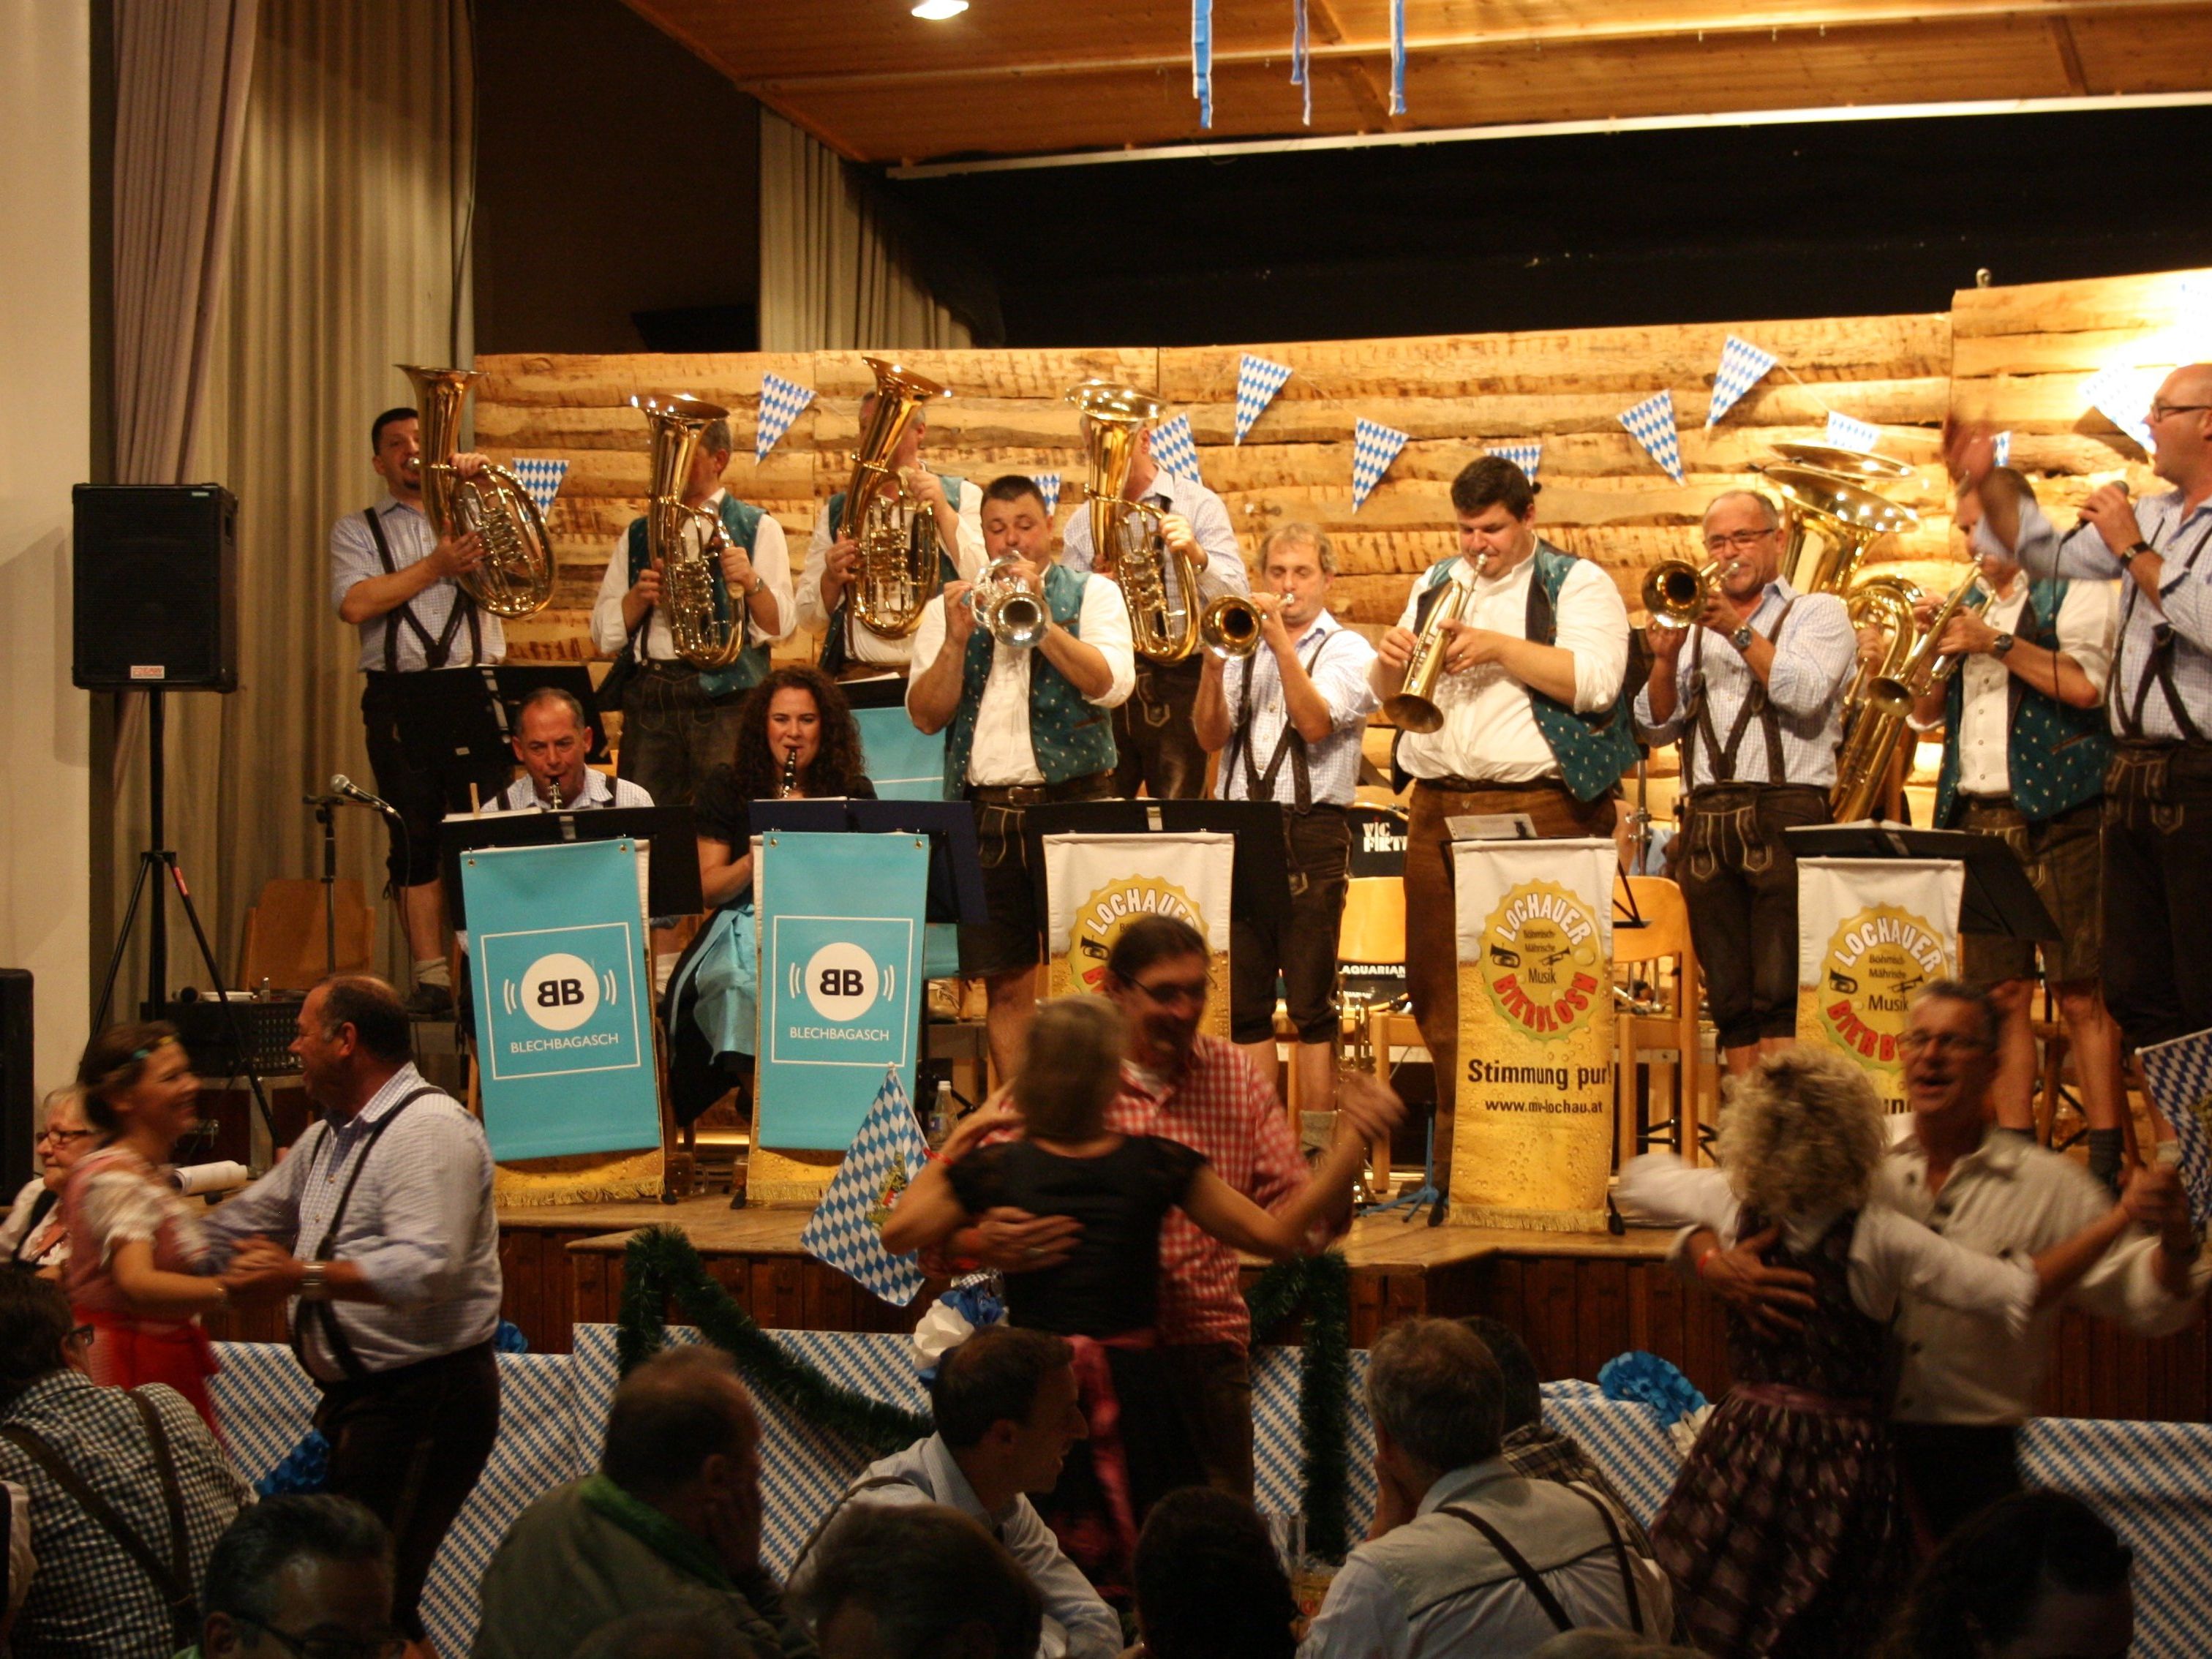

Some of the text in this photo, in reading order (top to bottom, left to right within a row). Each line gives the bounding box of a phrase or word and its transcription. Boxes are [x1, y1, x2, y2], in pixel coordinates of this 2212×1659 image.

[1362, 817, 1391, 837] VIC
[1495, 893, 1592, 945] LOCHAUER
[1834, 917, 1942, 974] LOCHAUER
[1342, 965, 1406, 975] AQUARIAN
[1528, 968, 1557, 984] Musik
[1868, 995, 1909, 1012] Musik
[511, 1033, 619, 1053] BLECHBAGASCH
[790, 1027, 889, 1041] BLECHBAGASCH
[1467, 1058, 1568, 1091] Stimmung
[1485, 1099, 1603, 1114] www.mv-lochau.at
